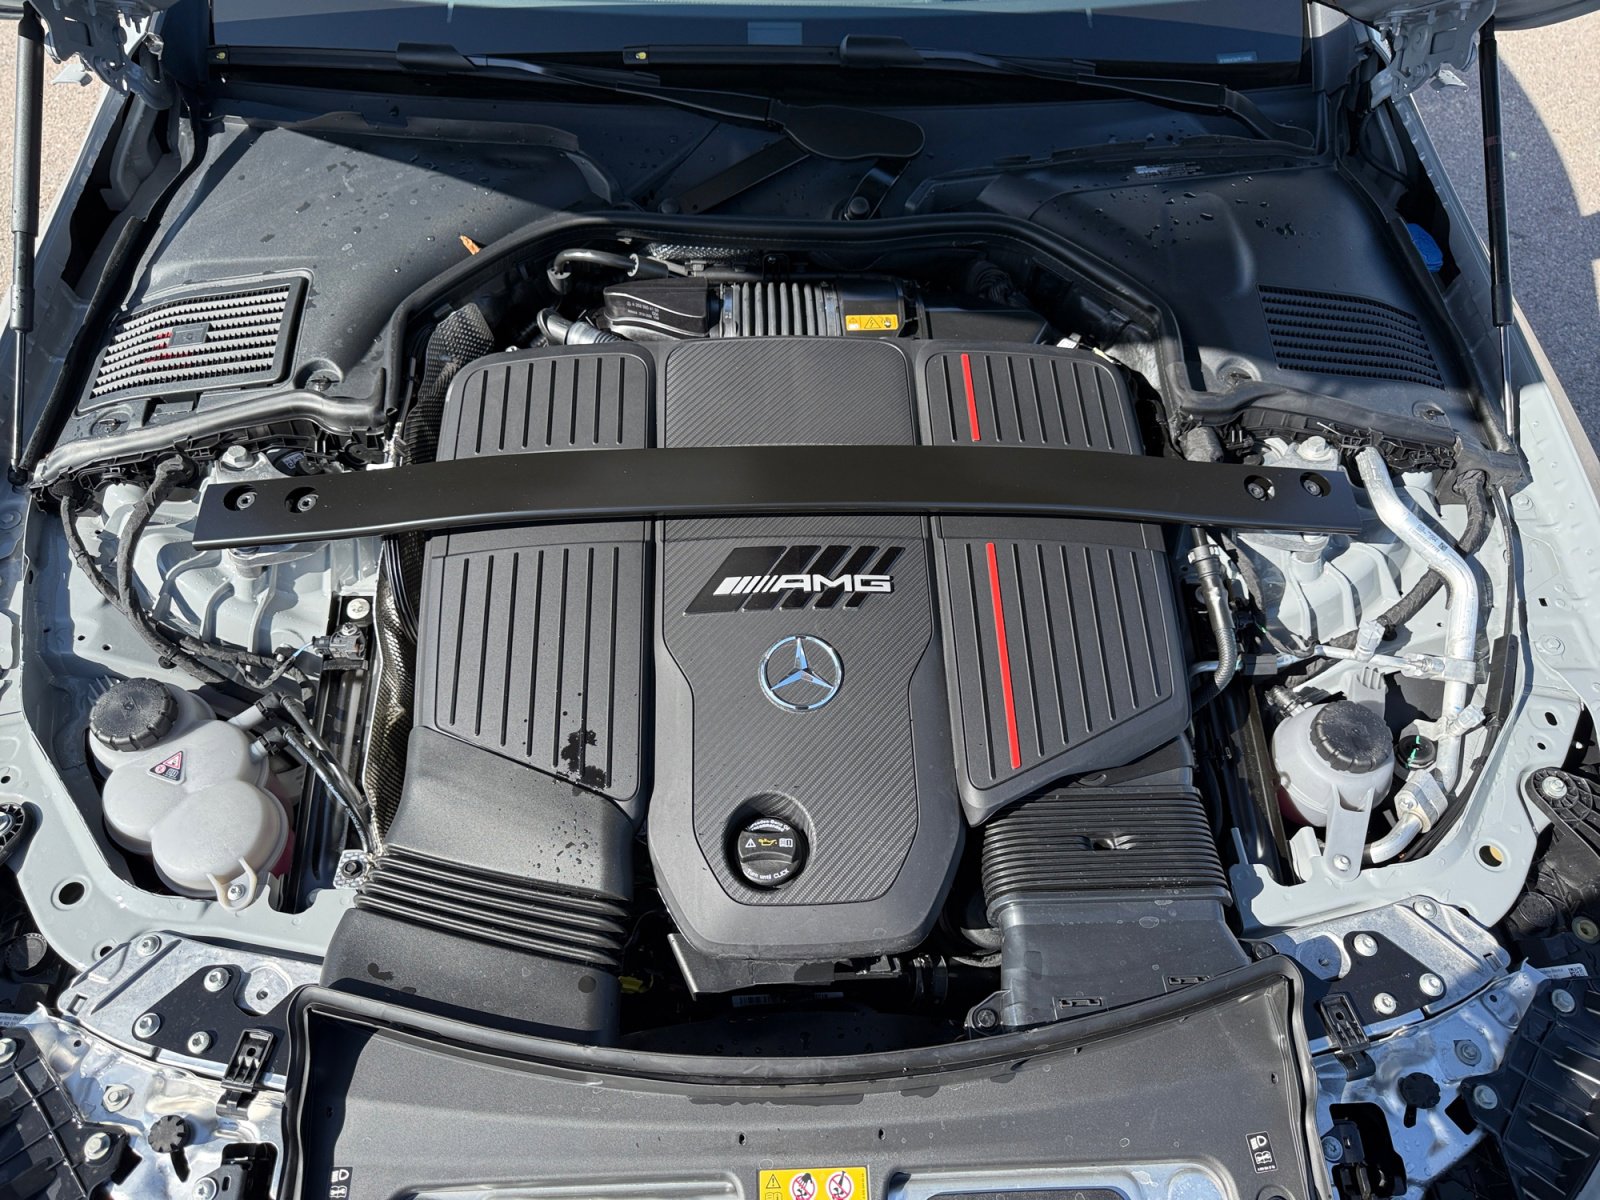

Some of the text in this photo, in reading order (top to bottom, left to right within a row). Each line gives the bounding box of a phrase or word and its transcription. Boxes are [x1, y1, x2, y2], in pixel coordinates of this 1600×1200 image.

[769, 574, 892, 593] AMG
[746, 868, 759, 878] Turn
[773, 868, 789, 879] CLICK
